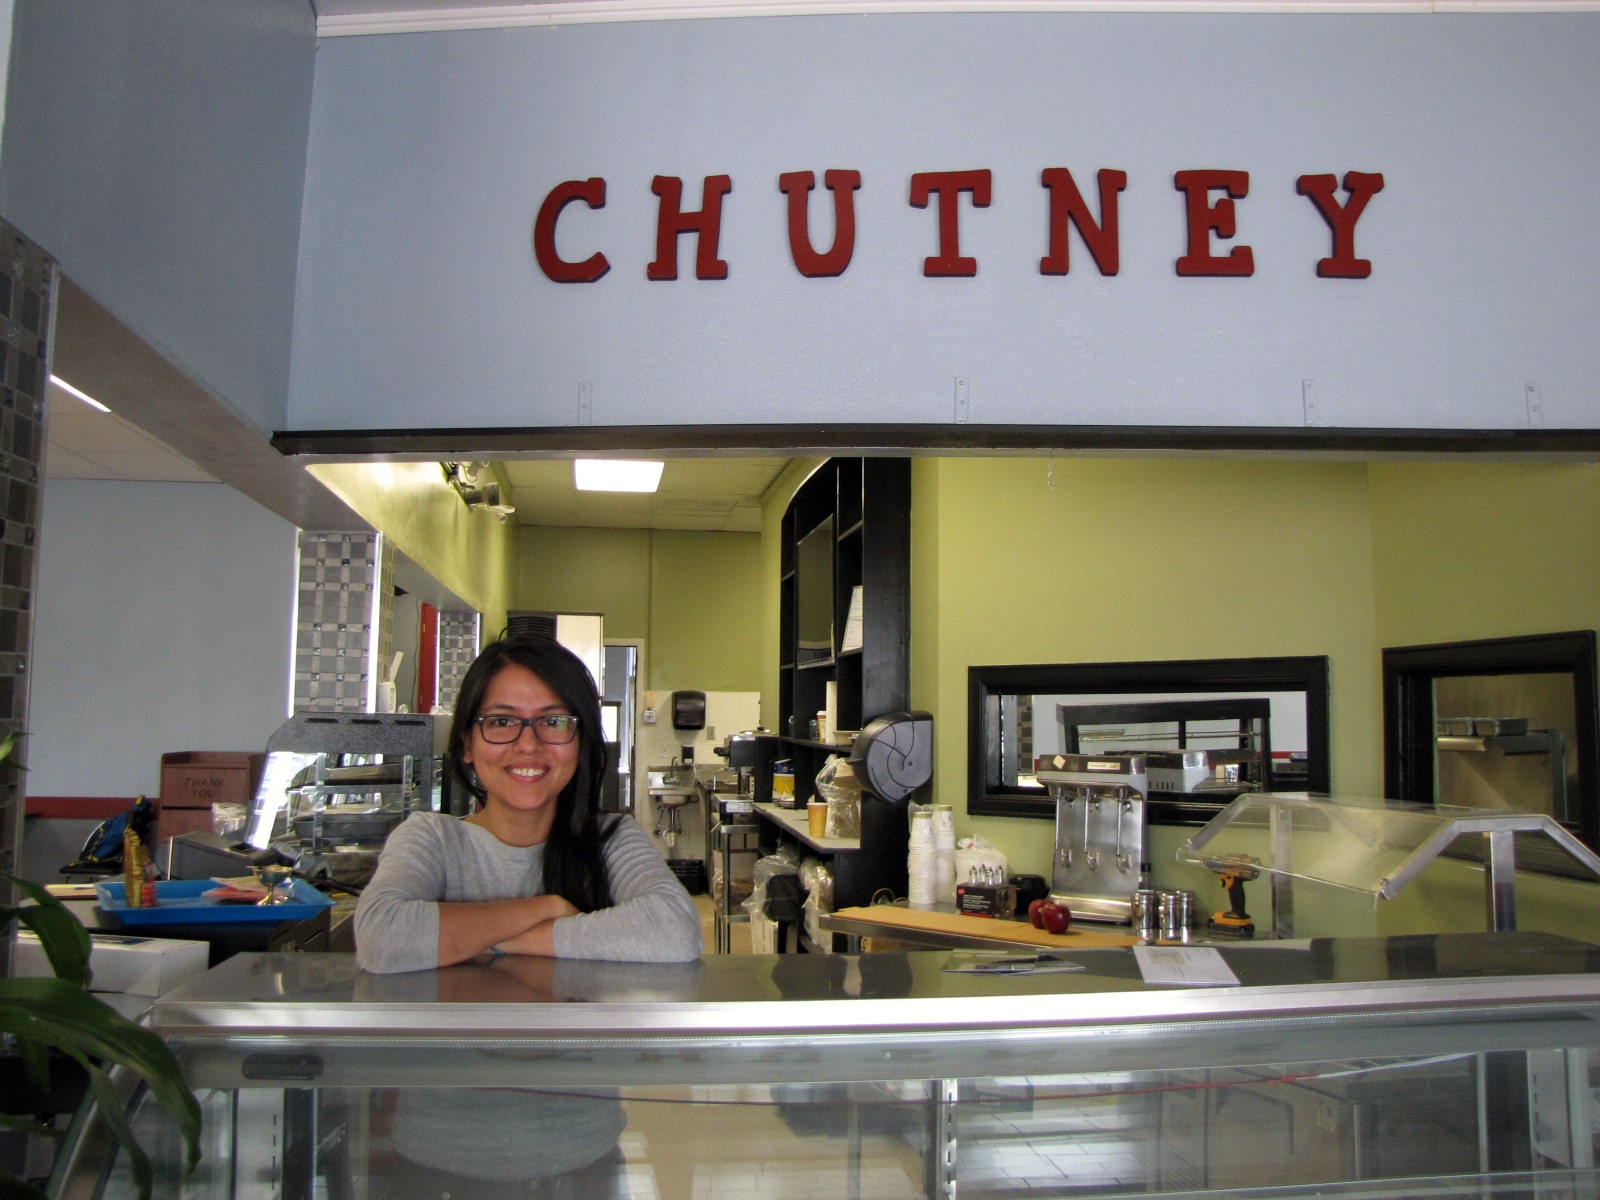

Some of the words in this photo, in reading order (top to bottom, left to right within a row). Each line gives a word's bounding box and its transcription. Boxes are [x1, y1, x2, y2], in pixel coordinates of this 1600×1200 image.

[533, 168, 1385, 283] CHUTNEY
[184, 777, 225, 788] THANK
[191, 787, 216, 798] YOU
